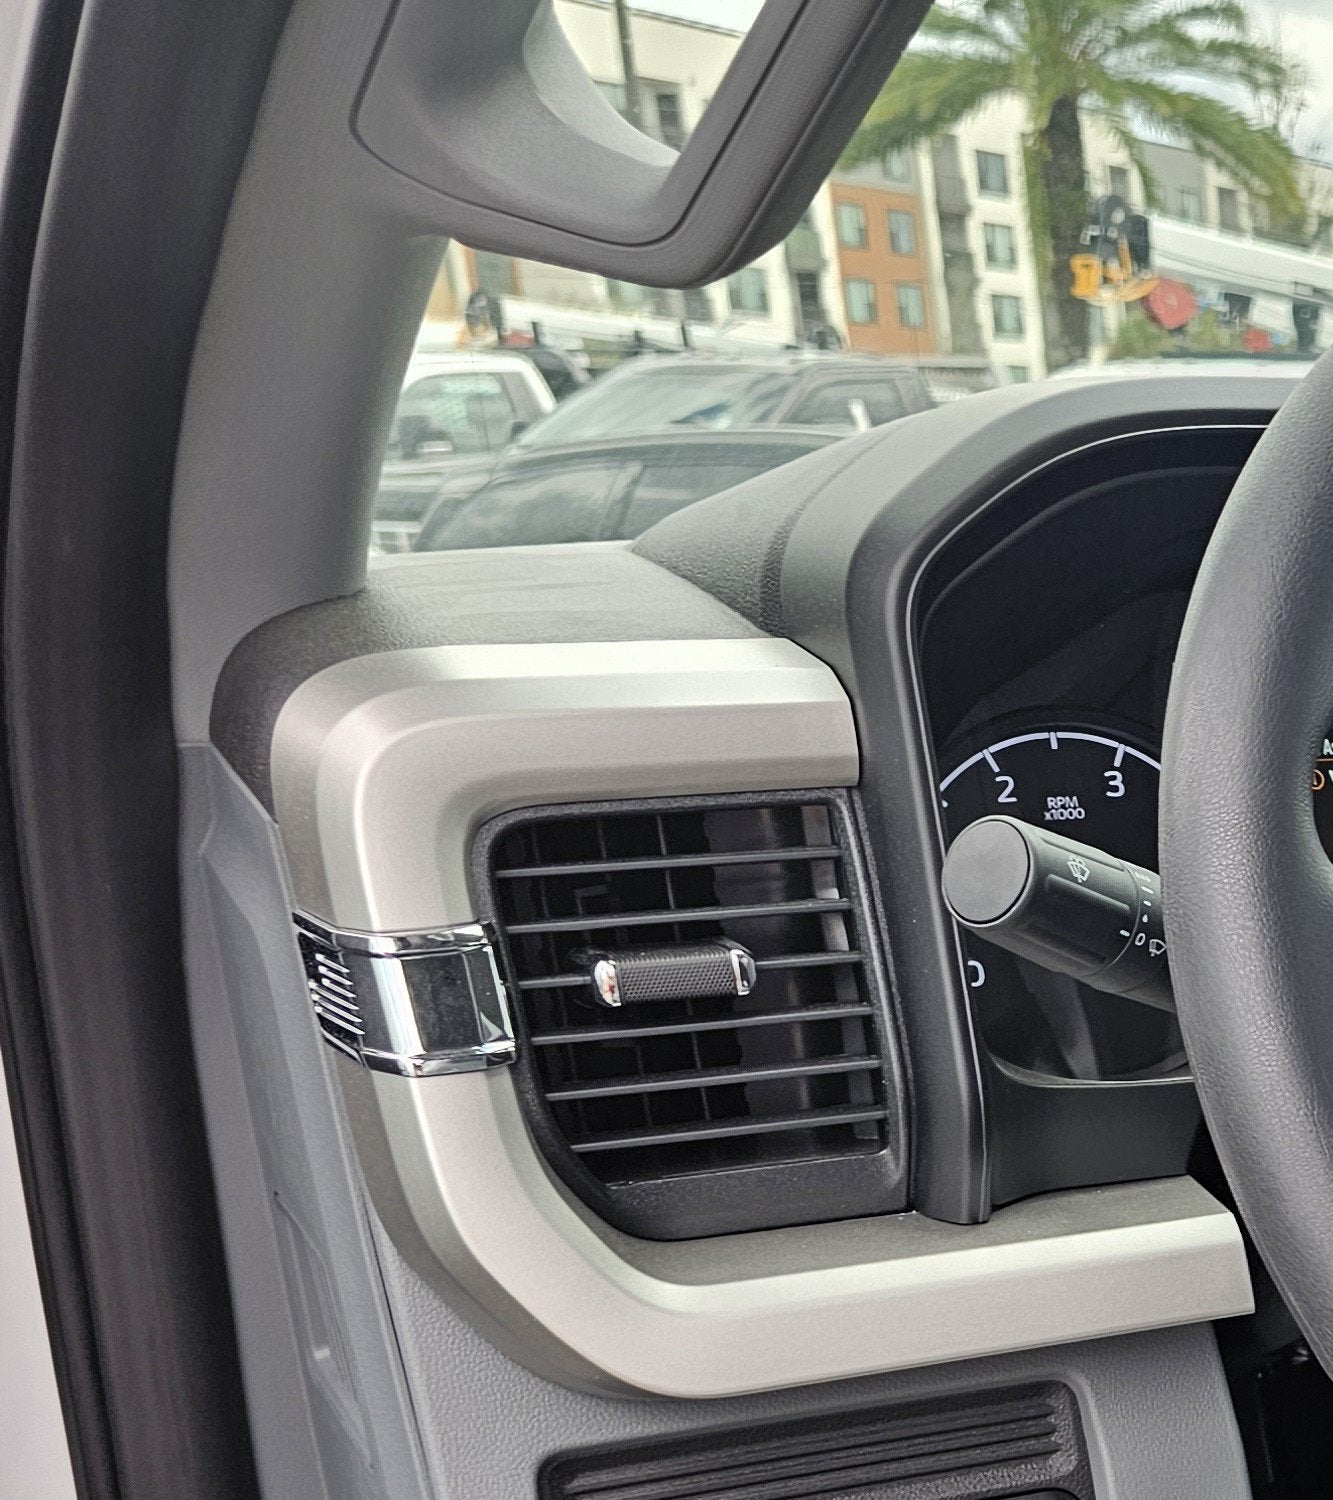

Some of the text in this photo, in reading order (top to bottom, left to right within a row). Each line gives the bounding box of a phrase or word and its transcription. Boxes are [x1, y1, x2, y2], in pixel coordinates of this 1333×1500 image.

[995, 776, 1018, 803] 2
[1104, 770, 1126, 797] 3
[1047, 796, 1079, 809] RPM
